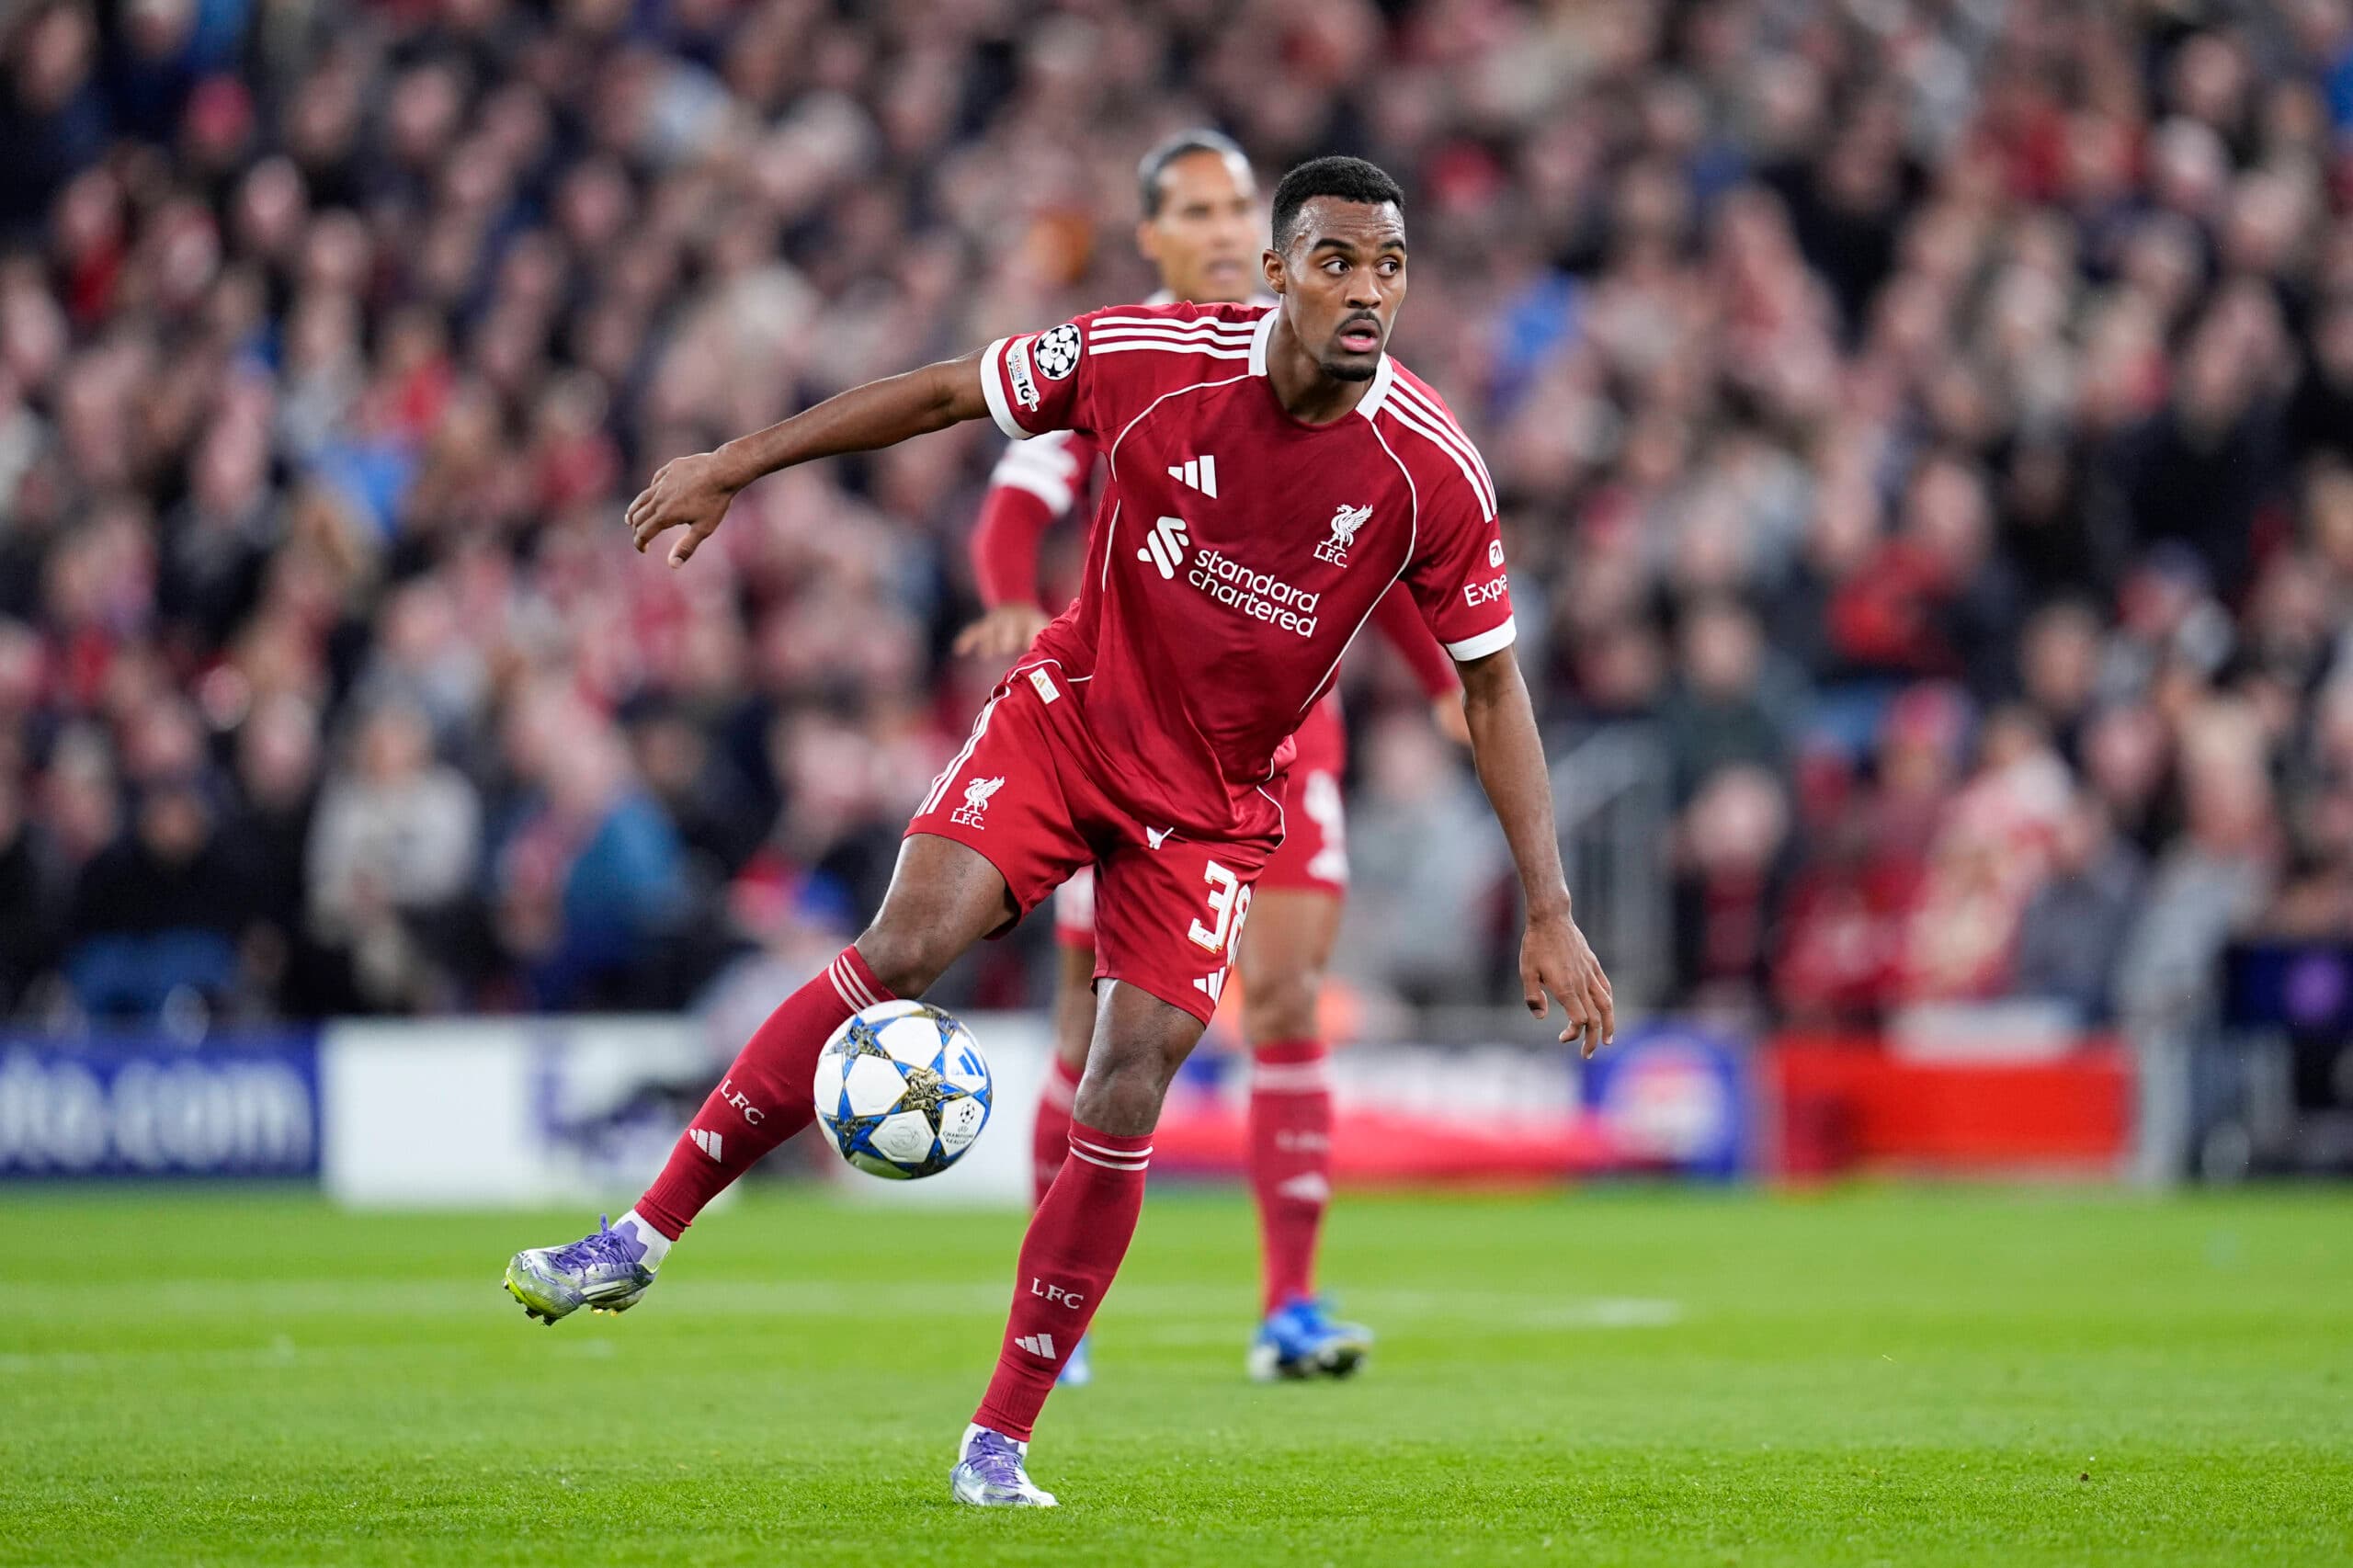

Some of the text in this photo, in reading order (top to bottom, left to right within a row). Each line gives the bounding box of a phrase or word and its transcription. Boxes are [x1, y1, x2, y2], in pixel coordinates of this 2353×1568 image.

[1188, 569, 1318, 638] chartered
[1194, 550, 1320, 614] standard
[1463, 574, 1507, 607] Expe
[1188, 859, 1251, 968] 38
[720, 1078, 765, 1125] LFC
[1030, 1277, 1084, 1310] LFC
